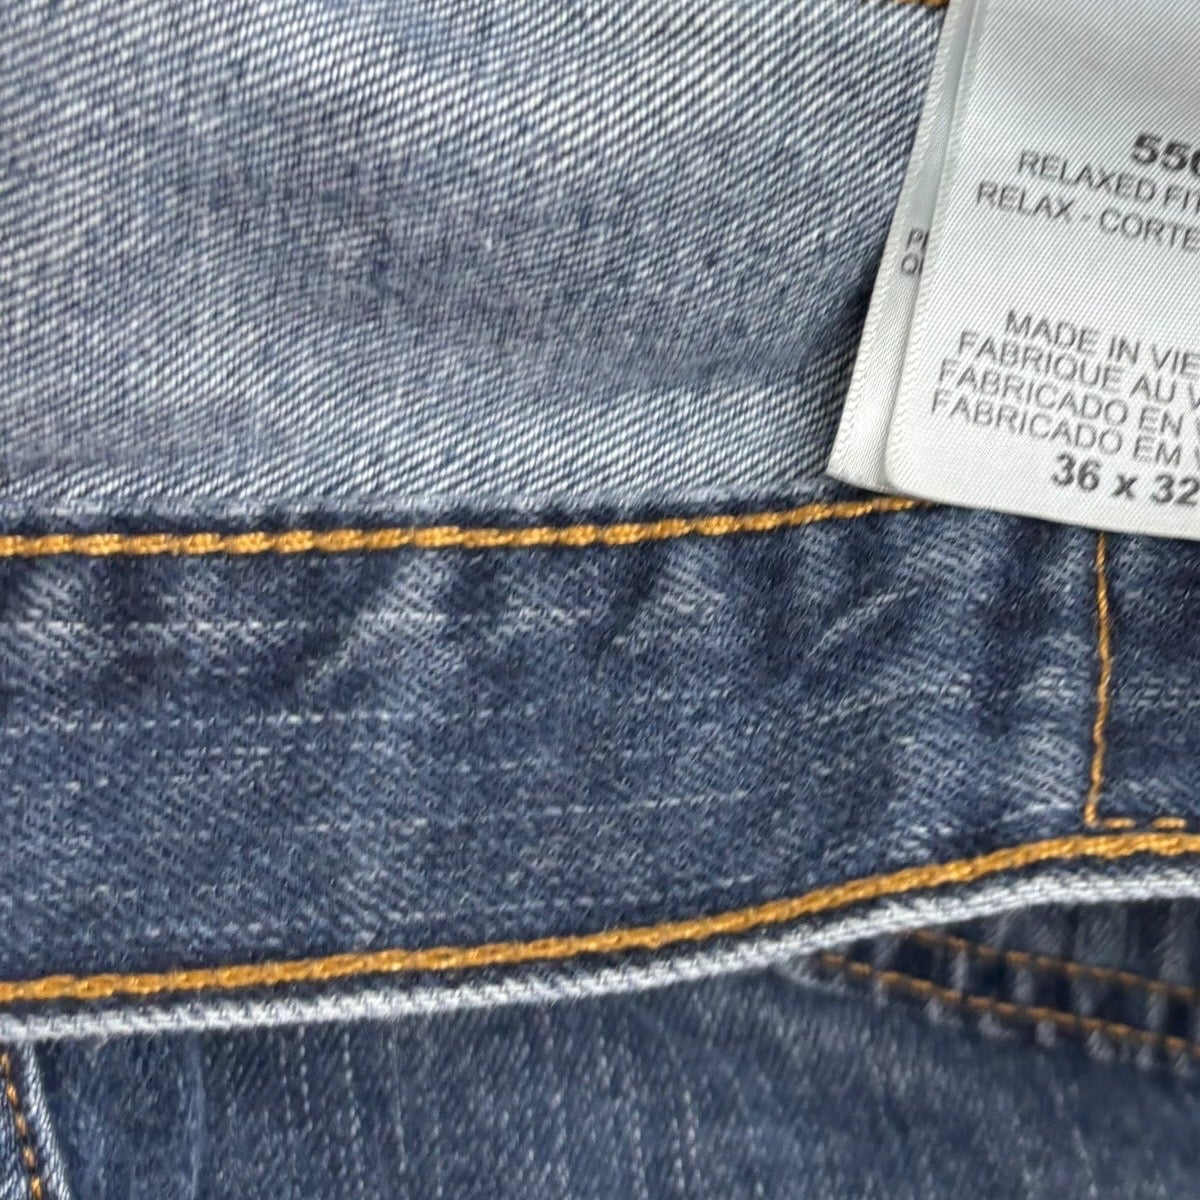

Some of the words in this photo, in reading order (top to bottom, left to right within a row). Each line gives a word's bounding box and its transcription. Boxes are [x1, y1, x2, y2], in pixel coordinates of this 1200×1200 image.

[976, 180, 1073, 223] RELAX
[1017, 149, 1157, 203] RELAXED
[1005, 310, 1098, 353] MADE
[1108, 337, 1141, 365] IN
[939, 358, 1127, 427] FABRICADO
[1138, 409, 1183, 439] EN
[1129, 378, 1176, 405] AU
[931, 387, 1123, 457] FABRICADO
[1133, 437, 1182, 467] EM
[1051, 453, 1101, 493] 36
